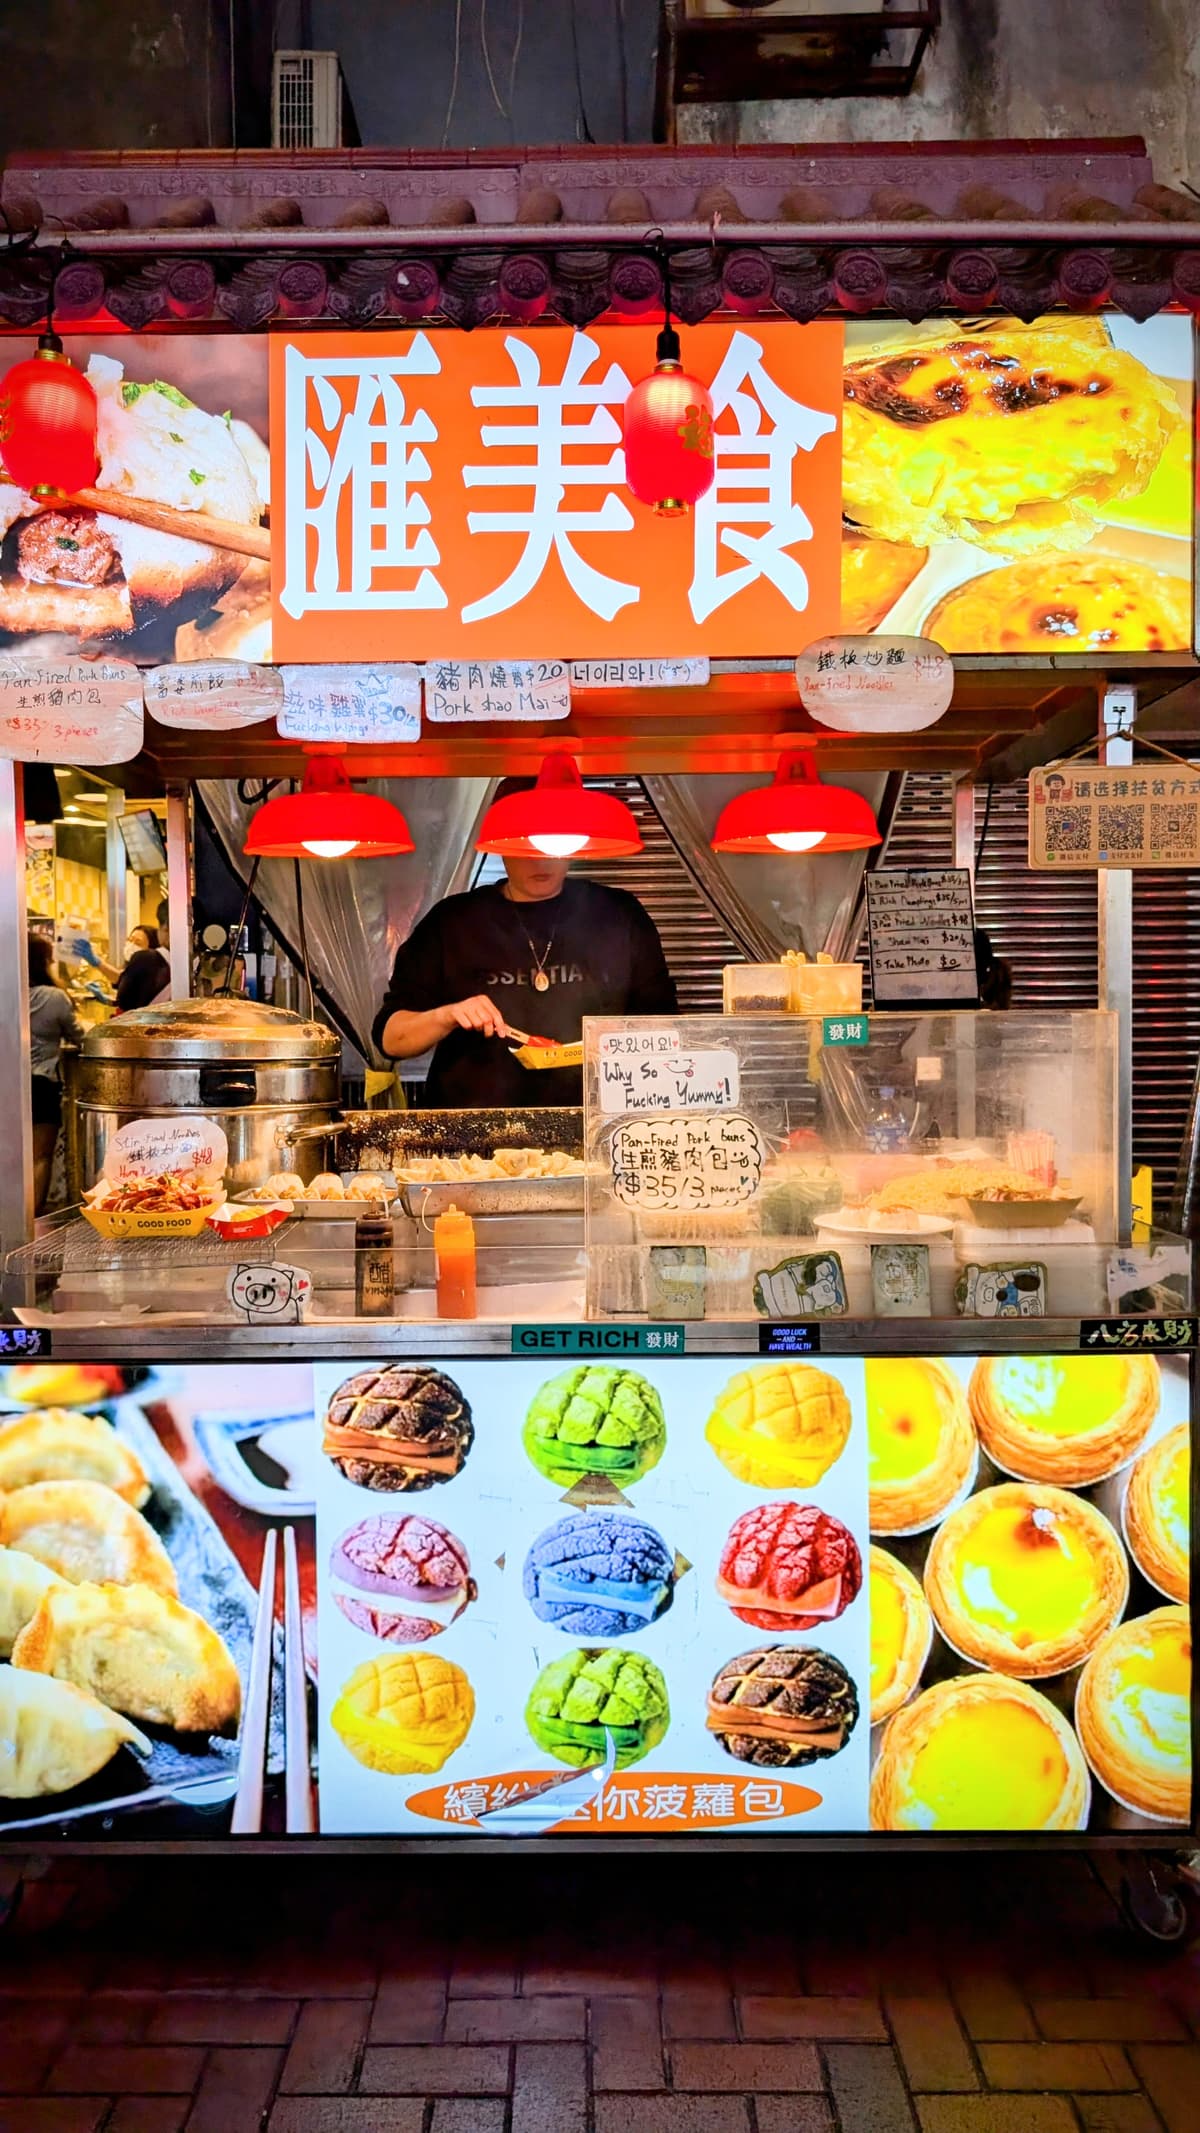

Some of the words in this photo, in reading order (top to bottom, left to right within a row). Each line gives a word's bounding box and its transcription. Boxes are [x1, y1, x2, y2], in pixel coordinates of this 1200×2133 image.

[281, 331, 837, 625] 匯美食
[912, 654, 945, 683] $48
[433, 692, 474, 718] Pork
[519, 691, 549, 712] Mai
[884, 960, 906, 969] Take
[828, 1021, 863, 1042] 發財
[609, 1037, 672, 1054] 맛있어요!
[603, 1061, 632, 1087] Why
[640, 1061, 658, 1081] So
[623, 1087, 671, 1109] Fucking
[675, 1077, 732, 1106] Yummy!
[621, 1132, 678, 1149] Pan-Fired
[687, 1131, 711, 1146] Pork
[721, 1128, 746, 1144] buns
[191, 1147, 213, 1169] $48
[137, 1219, 164, 1229] GOOD
[166, 1217, 192, 1228] FOOD
[520, 1330, 572, 1348] GET
[578, 1330, 640, 1348] RICH
[646, 1330, 680, 1349] 發財
[772, 1328, 791, 1336] GOOD
[790, 1328, 807, 1336] LUCK
[781, 1335, 797, 1343] AND
[768, 1342, 786, 1351] HAVE
[443, 1782, 784, 1822] 繽你菠蘿包
